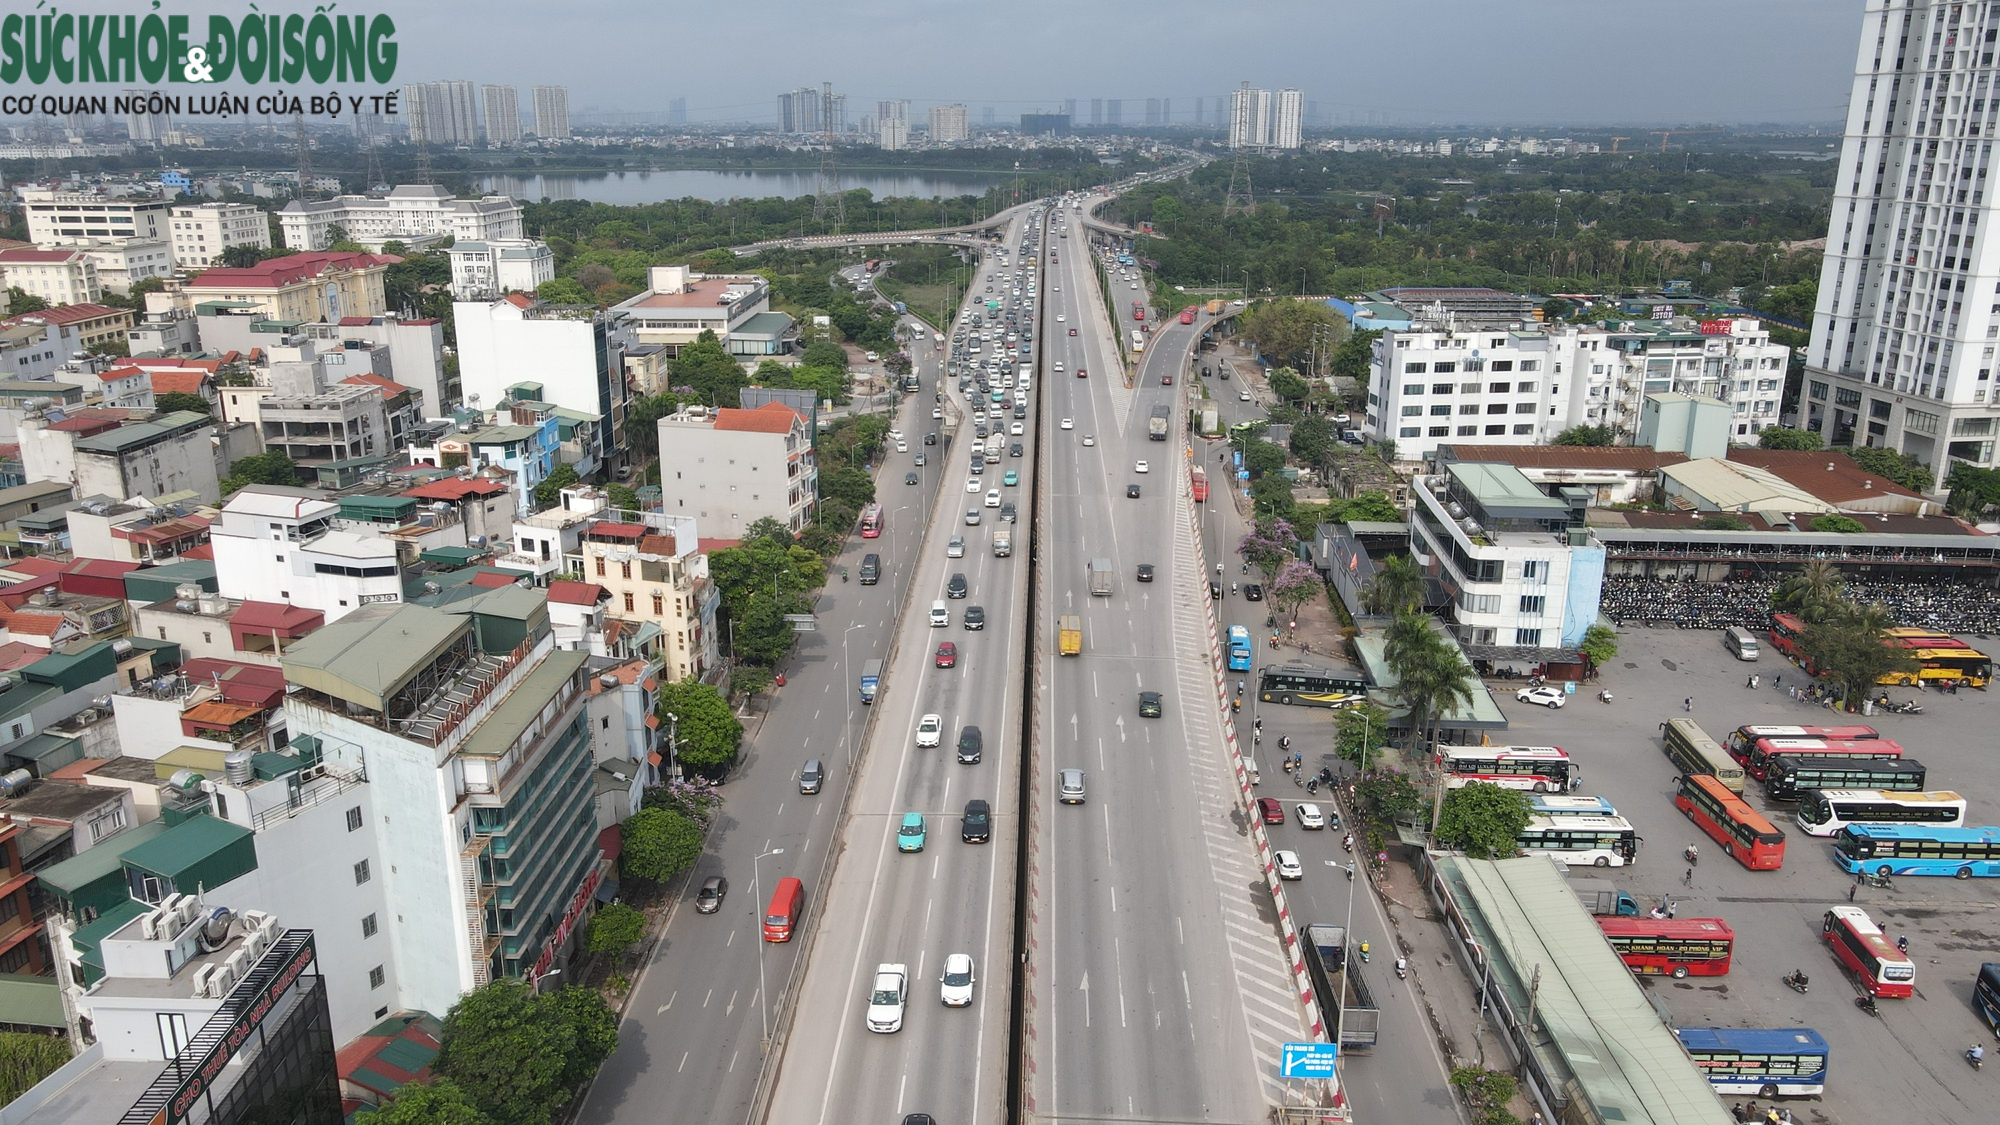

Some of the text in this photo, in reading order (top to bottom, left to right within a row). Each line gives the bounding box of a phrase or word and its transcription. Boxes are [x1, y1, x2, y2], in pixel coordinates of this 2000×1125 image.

[1700, 326, 1733, 335] HOTEL
[173, 947, 312, 1117] CHO THUÊ TÒA NHÀ BUILDING
